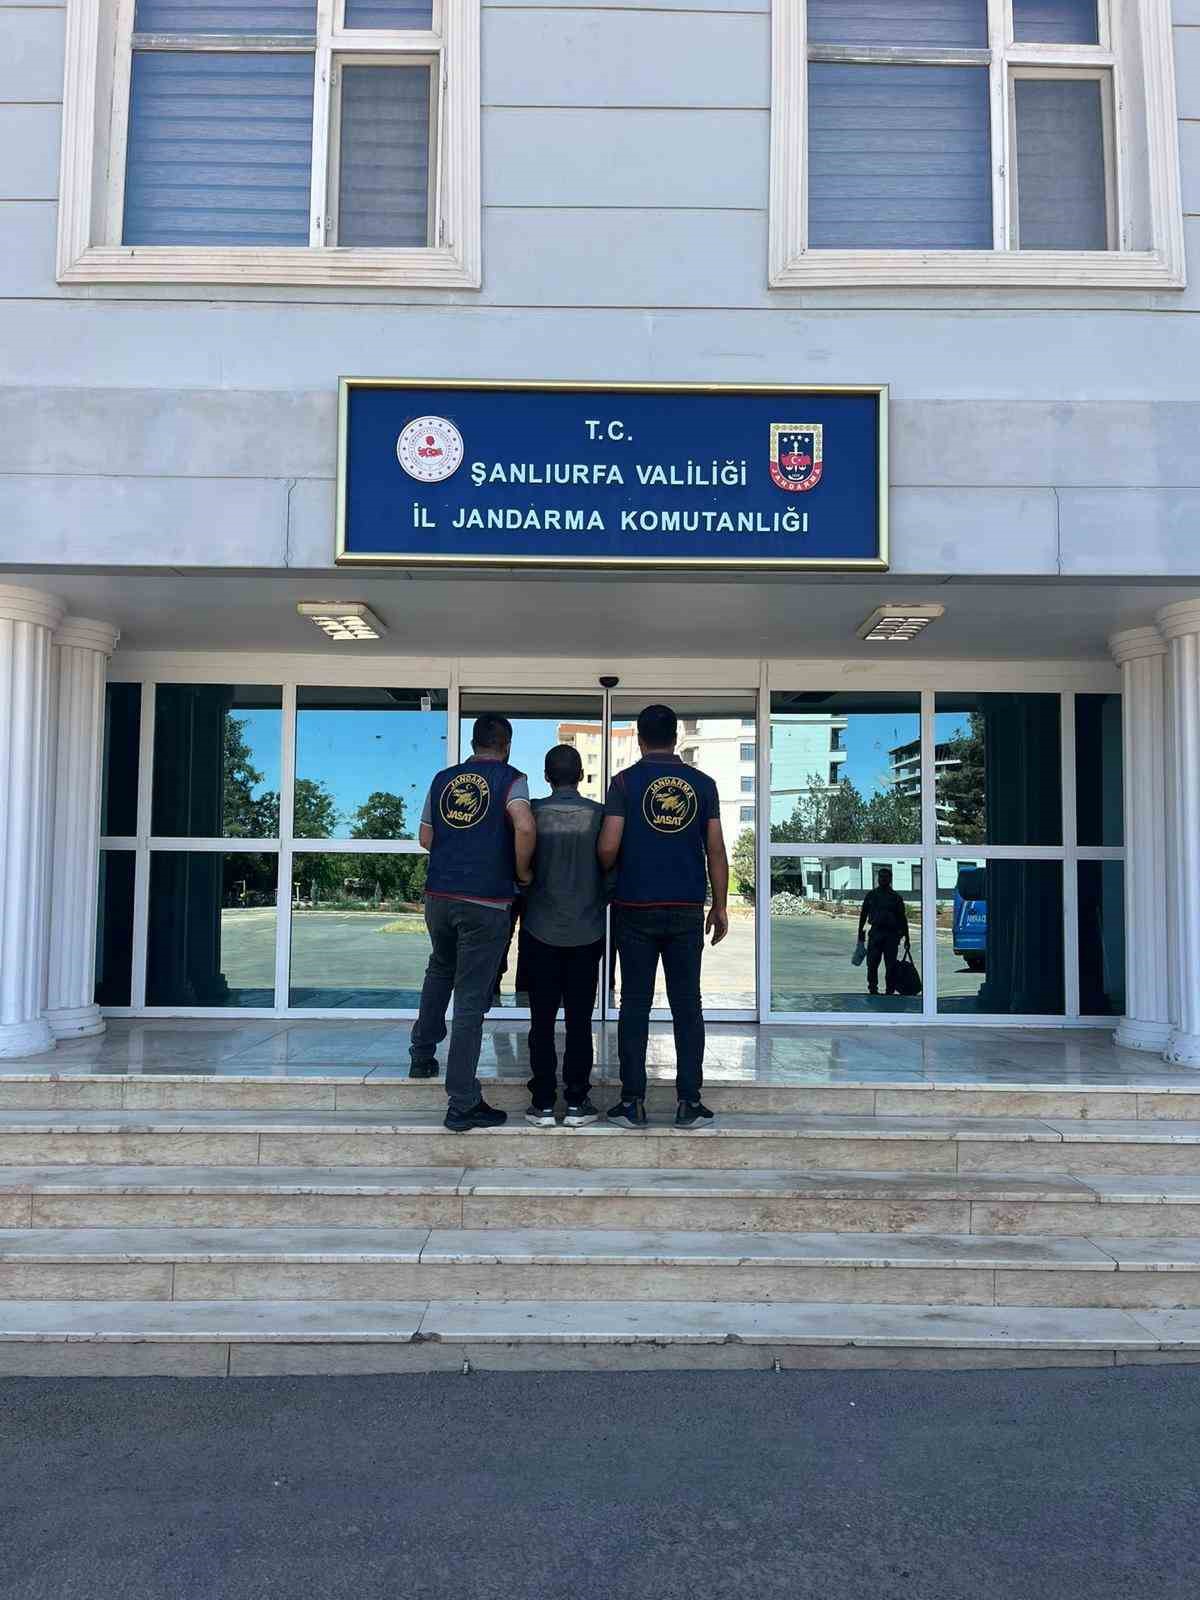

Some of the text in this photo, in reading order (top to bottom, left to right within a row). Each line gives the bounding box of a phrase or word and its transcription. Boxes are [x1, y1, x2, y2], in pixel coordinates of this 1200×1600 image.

[586, 420, 633, 441] T.C.
[471, 460, 746, 487] ŞANLIURFA VALİLİĞİ
[413, 502, 808, 532] İL JANDARMA KOMUTANLIĞI
[650, 778, 695, 799] JANDARMA
[446, 809, 473, 823] JASAT
[652, 814, 683, 826] JASAT
